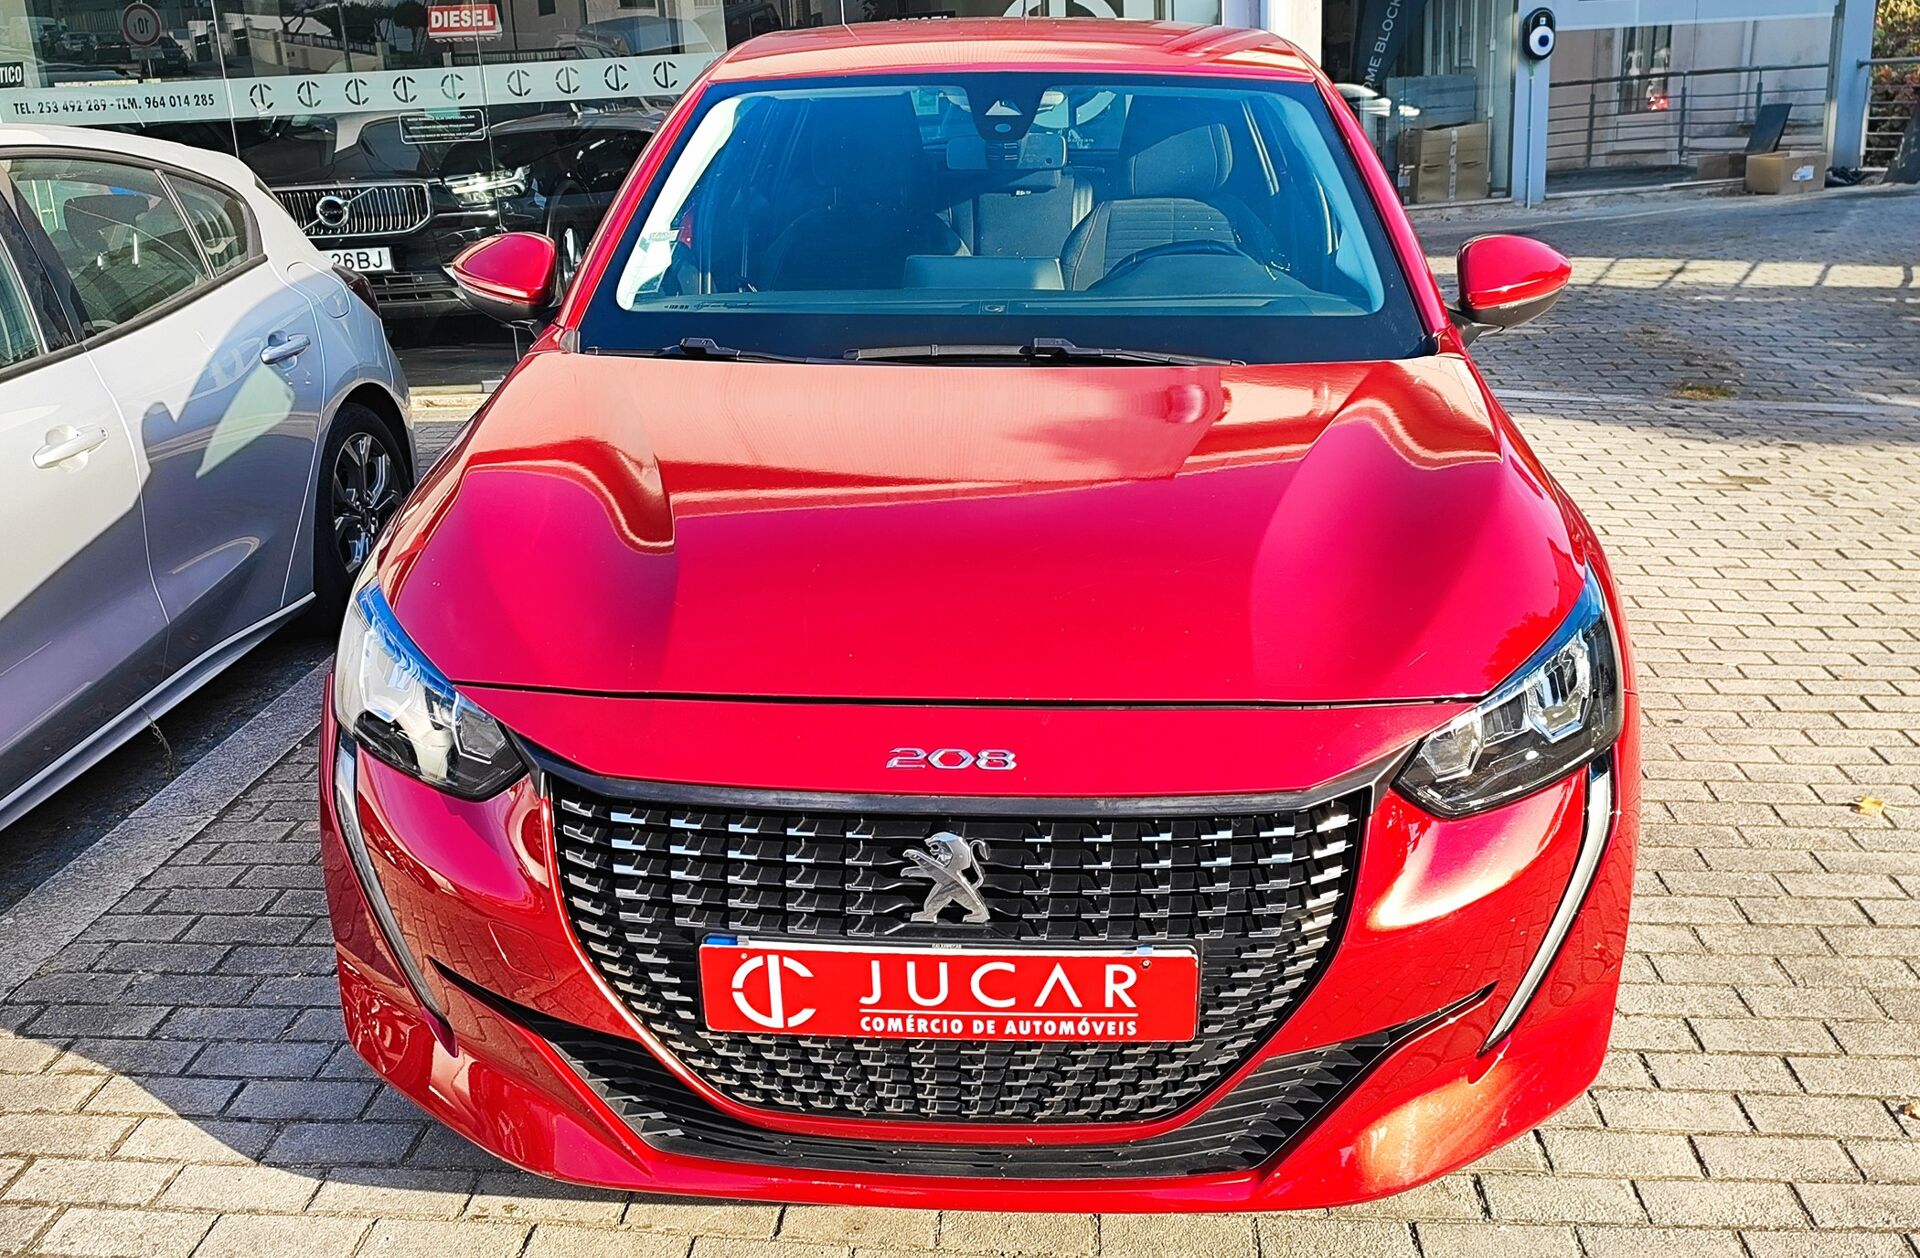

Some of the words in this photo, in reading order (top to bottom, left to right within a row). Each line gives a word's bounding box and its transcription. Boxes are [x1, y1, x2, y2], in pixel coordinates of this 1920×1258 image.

[430, 9, 494, 28] DIESEL
[13, 102, 35, 114] TEL.
[38, 101, 59, 113] 253
[62, 100, 83, 112] 492
[86, 98, 107, 111] 289
[144, 96, 166, 109] 964
[169, 94, 190, 108] 014
[193, 93, 215, 107] 285
[886, 747, 1017, 770] 208
[859, 960, 1137, 1008] JUCAR
[860, 1014, 964, 1034] COMÉRCIO
[972, 1019, 996, 1034] DE
[1004, 1017, 1137, 1036] AUTOMÓVEIS
